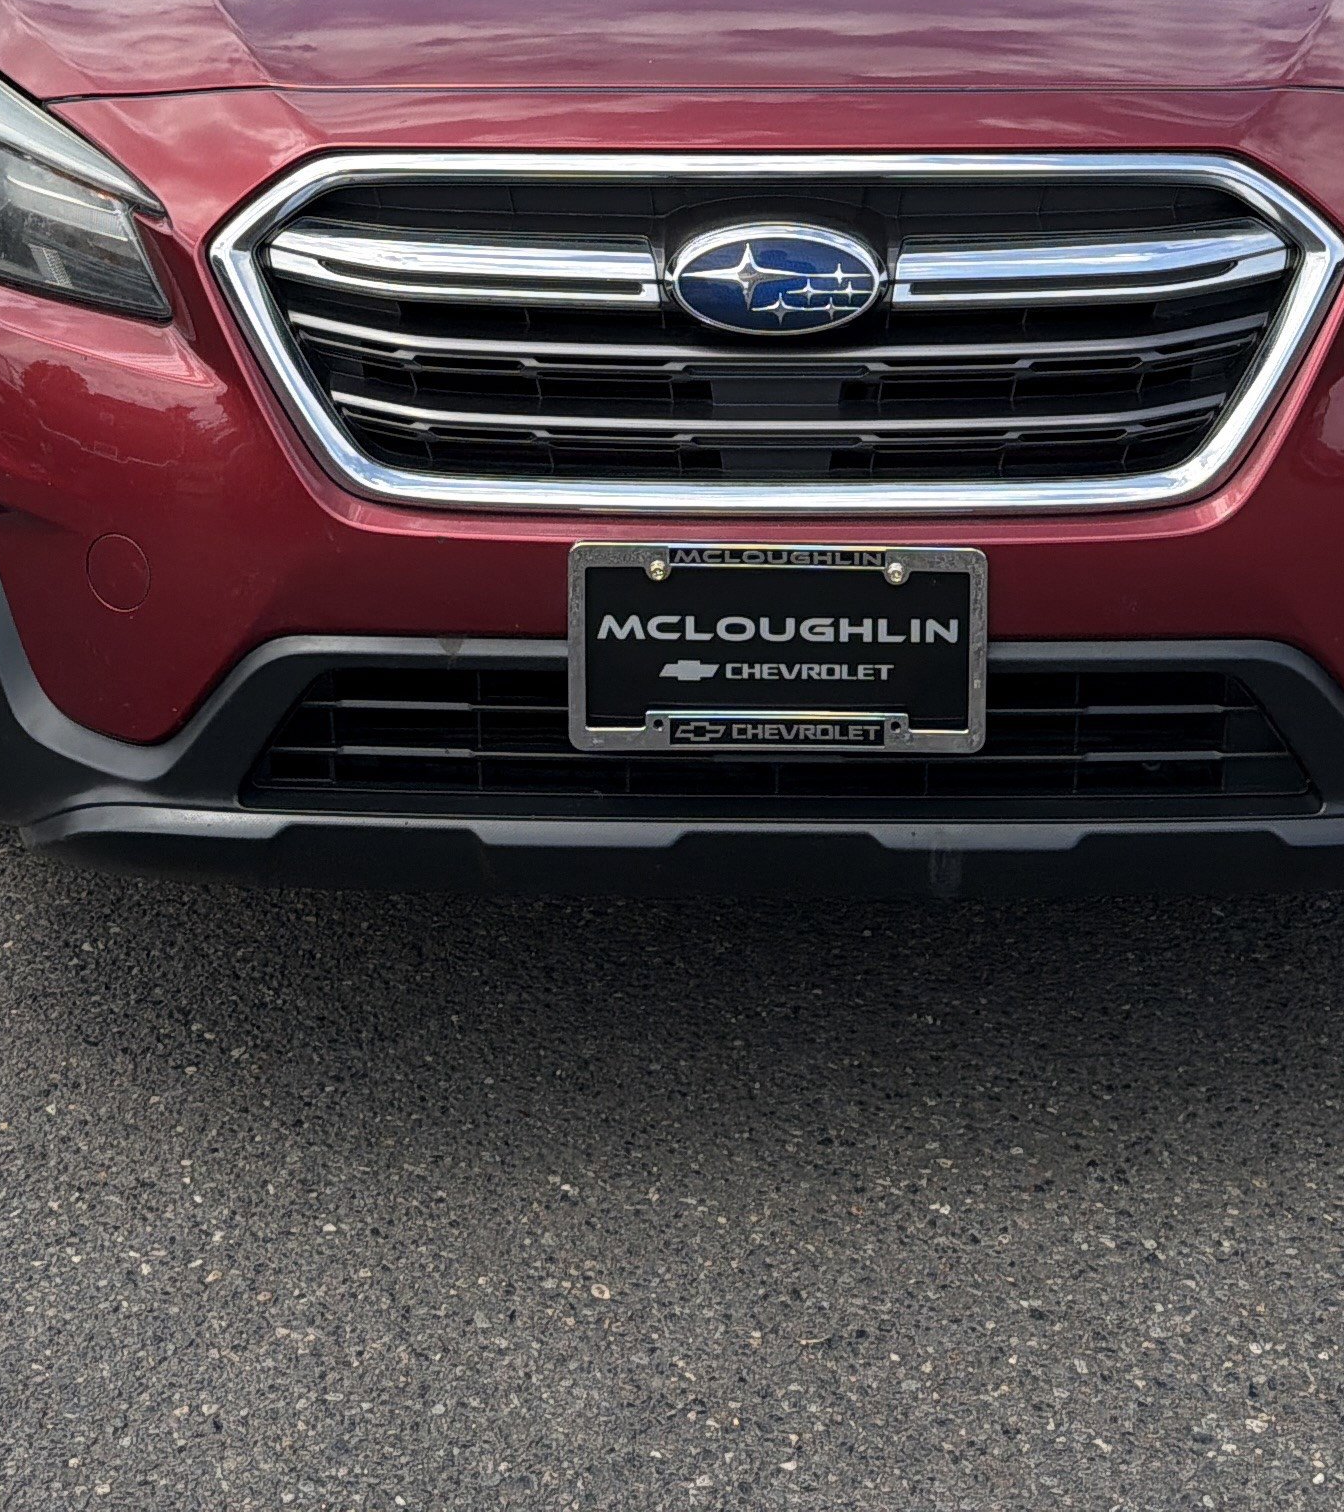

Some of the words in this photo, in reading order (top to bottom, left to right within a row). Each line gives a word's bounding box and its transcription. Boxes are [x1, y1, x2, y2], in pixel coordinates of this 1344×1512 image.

[673, 549, 883, 566] MCLOUGHLIN
[597, 614, 958, 643] MCLOUGHLIN
[725, 663, 895, 681] CHEVROLET
[731, 724, 881, 741] CHEVROLET
